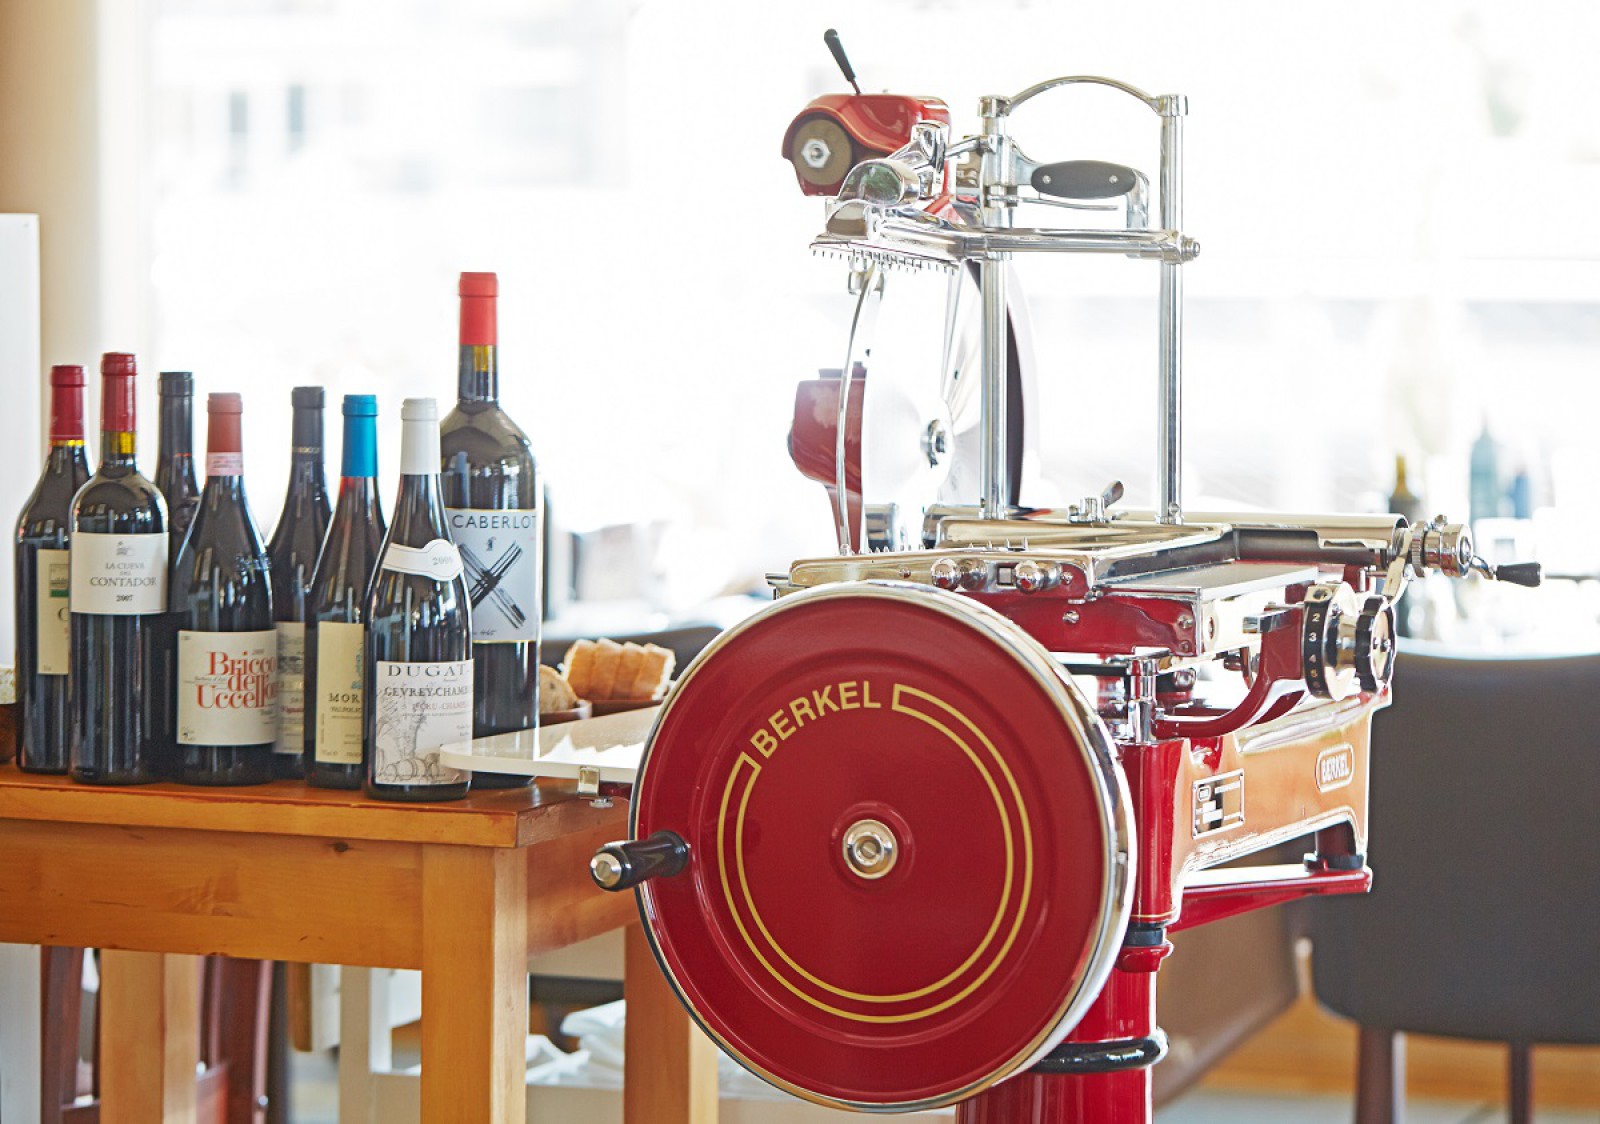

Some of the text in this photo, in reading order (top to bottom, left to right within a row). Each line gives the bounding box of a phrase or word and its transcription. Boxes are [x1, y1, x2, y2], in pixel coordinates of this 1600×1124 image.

[90, 576, 157, 588] CONTADOR
[1312, 612, 1320, 622] 2
[1308, 631, 1317, 642] 3
[1308, 653, 1317, 663] 4
[751, 680, 882, 759] BERKEL
[1320, 752, 1349, 784] BERKEL
